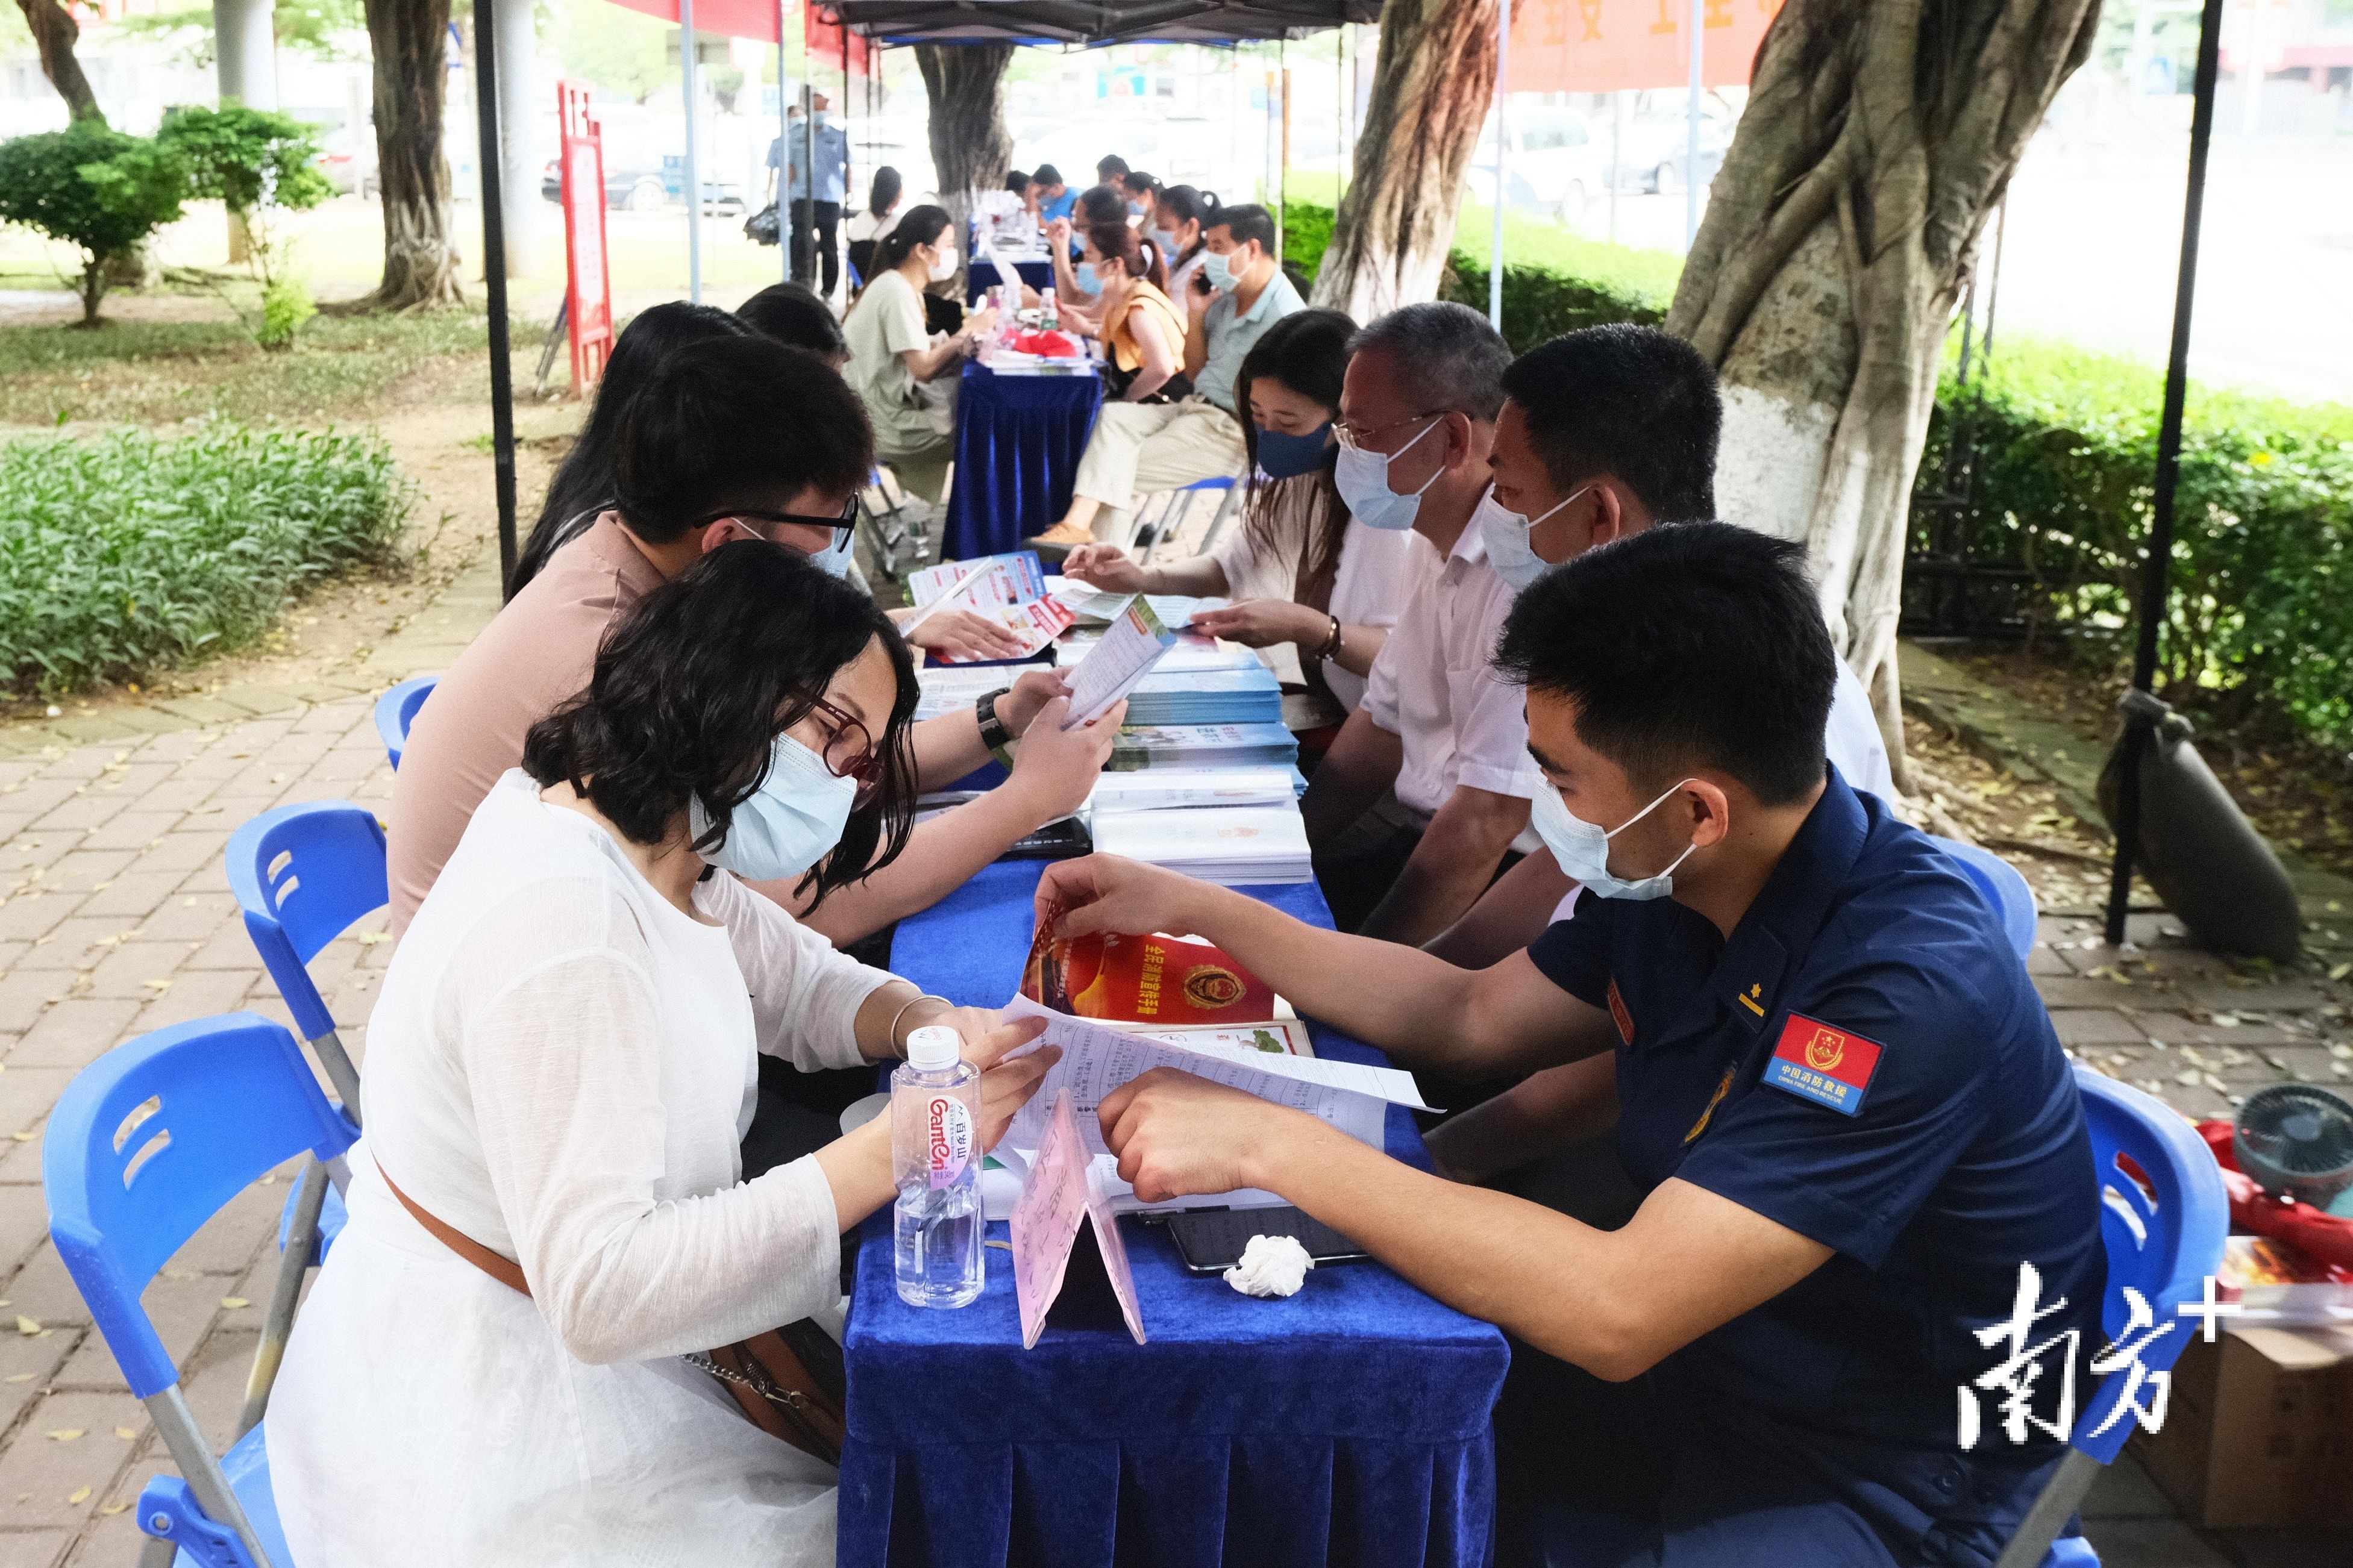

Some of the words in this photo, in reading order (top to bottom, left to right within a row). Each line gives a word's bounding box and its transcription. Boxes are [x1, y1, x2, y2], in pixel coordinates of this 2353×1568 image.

[1136, 945, 1165, 1014] 全民消防宣传手册
[1778, 1076, 1794, 1084] CHINA
[1806, 1086, 1820, 1095] AND
[1819, 1091, 1843, 1104] RESCUE
[1782, 1065, 1847, 1097] 中国消防救援
[956, 1122, 967, 1158] 百岁山
